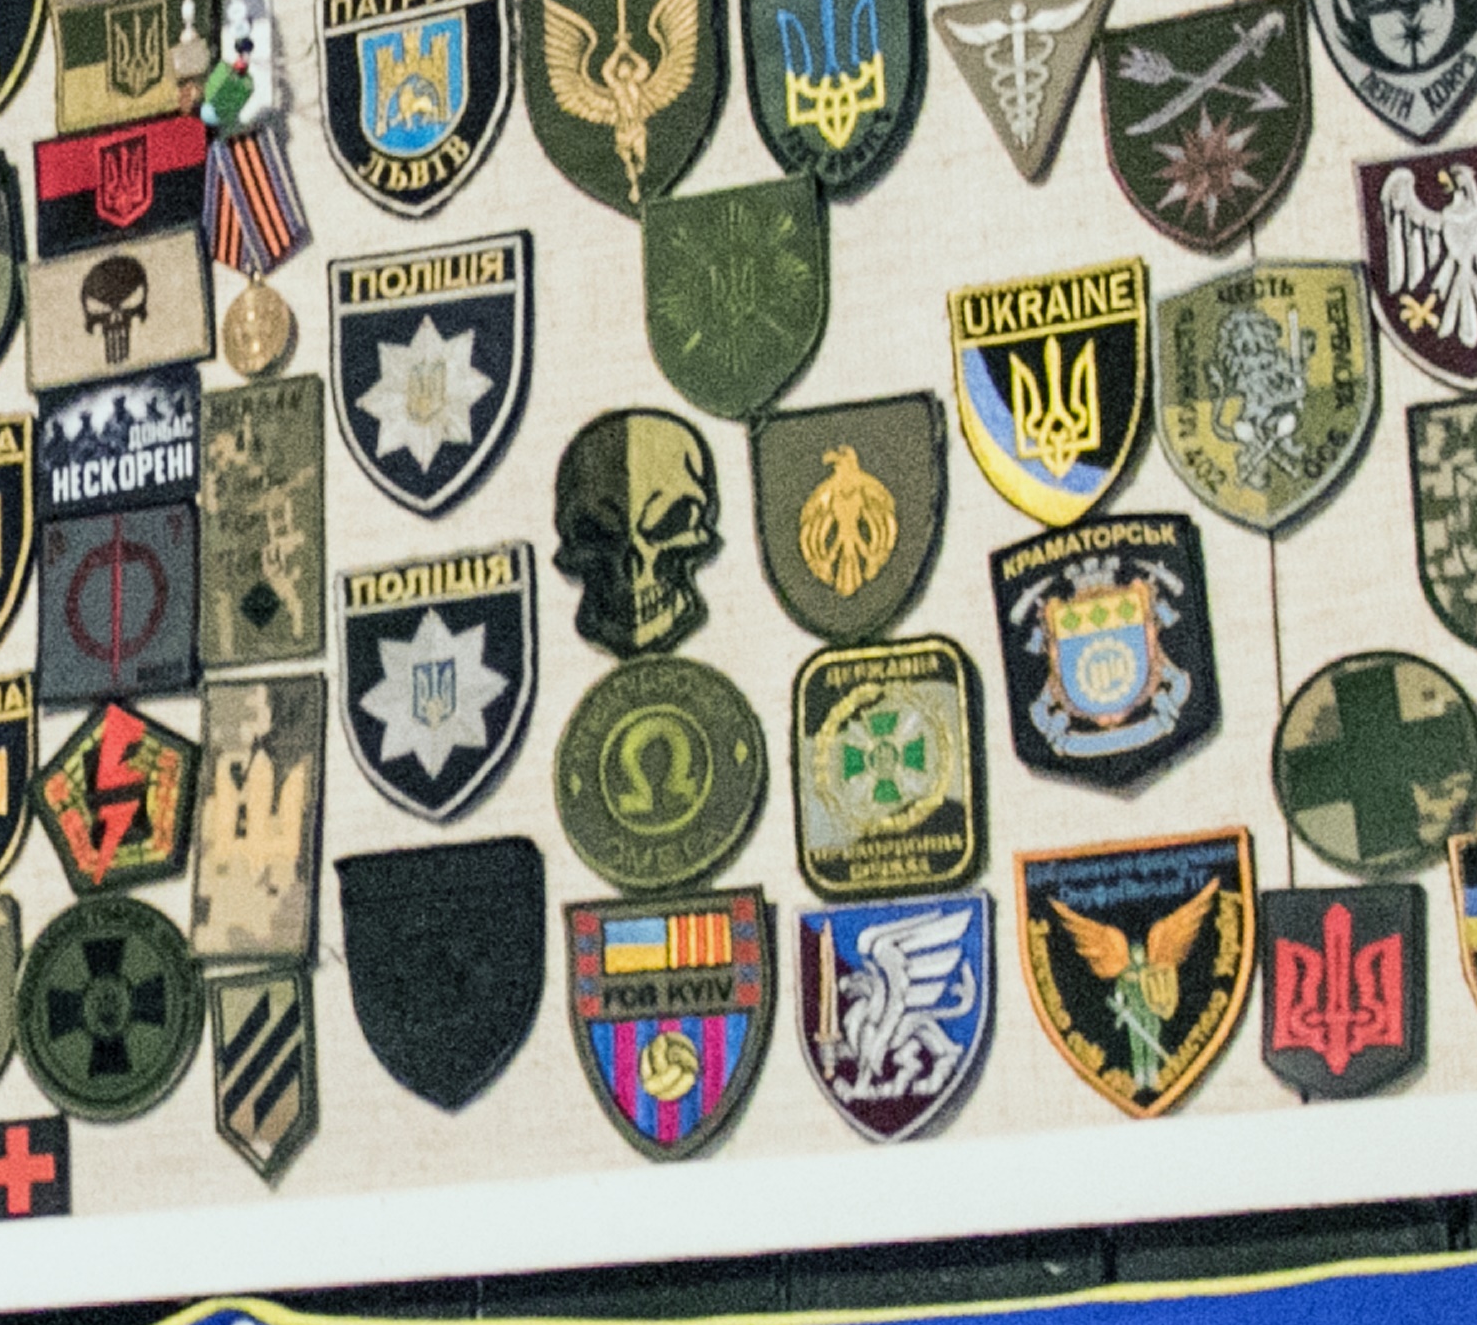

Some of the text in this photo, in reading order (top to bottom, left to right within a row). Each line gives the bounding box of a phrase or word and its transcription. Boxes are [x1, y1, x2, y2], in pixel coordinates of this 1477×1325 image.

[358, 134, 473, 193] ЛЬВІВ
[350, 250, 507, 302] ПОЛІЦІЯ
[961, 270, 1137, 337] UKRAINE
[127, 413, 194, 452] ДОНБАС
[51, 443, 194, 505] НЕСКОРЕНІ
[349, 552, 514, 609] ПОЛІЦІЯ
[1001, 522, 1179, 581] КРАМАТОРСЬК
[666, 975, 735, 1007] KYIV
